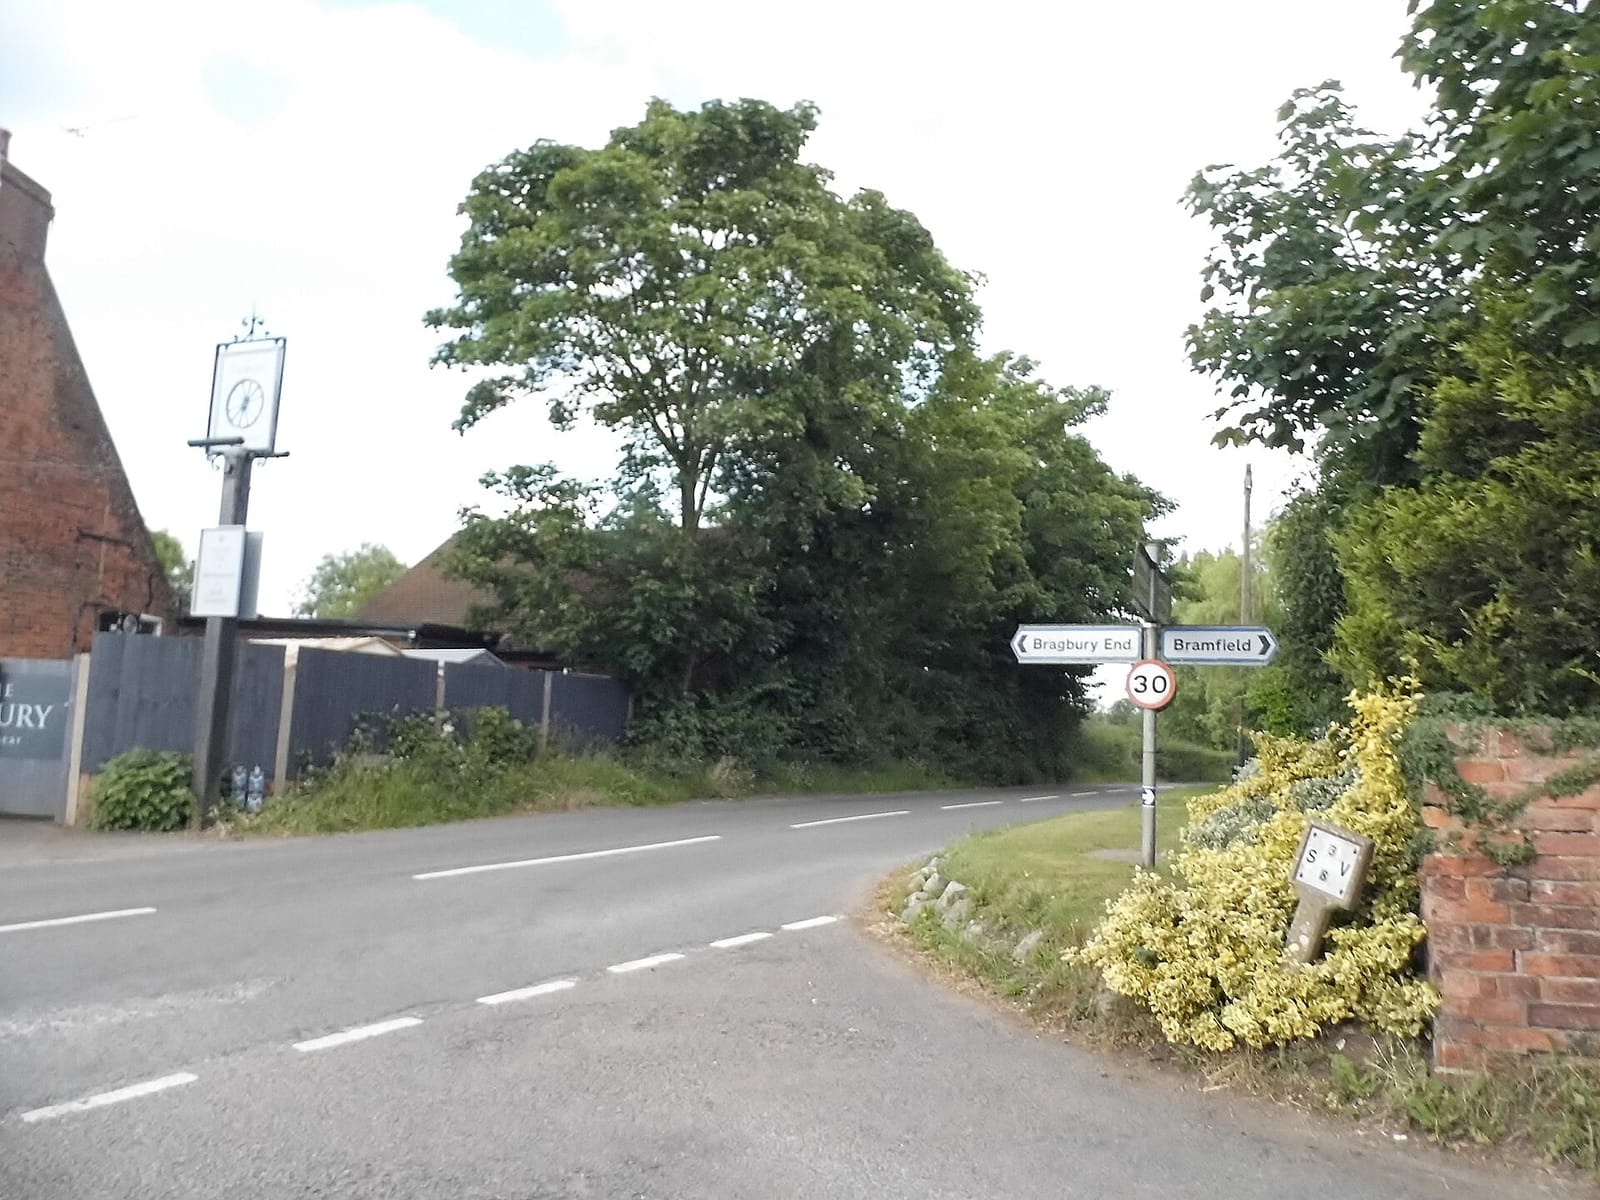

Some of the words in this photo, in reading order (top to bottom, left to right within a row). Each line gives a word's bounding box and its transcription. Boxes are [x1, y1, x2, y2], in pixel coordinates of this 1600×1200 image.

[1033, 638, 1098, 652] Bragbury
[1104, 638, 1132, 650] End
[1174, 638, 1252, 652] Bramfield
[1134, 675, 1168, 694] 30
[1306, 848, 1318, 864] S
[1340, 860, 1351, 877] V
